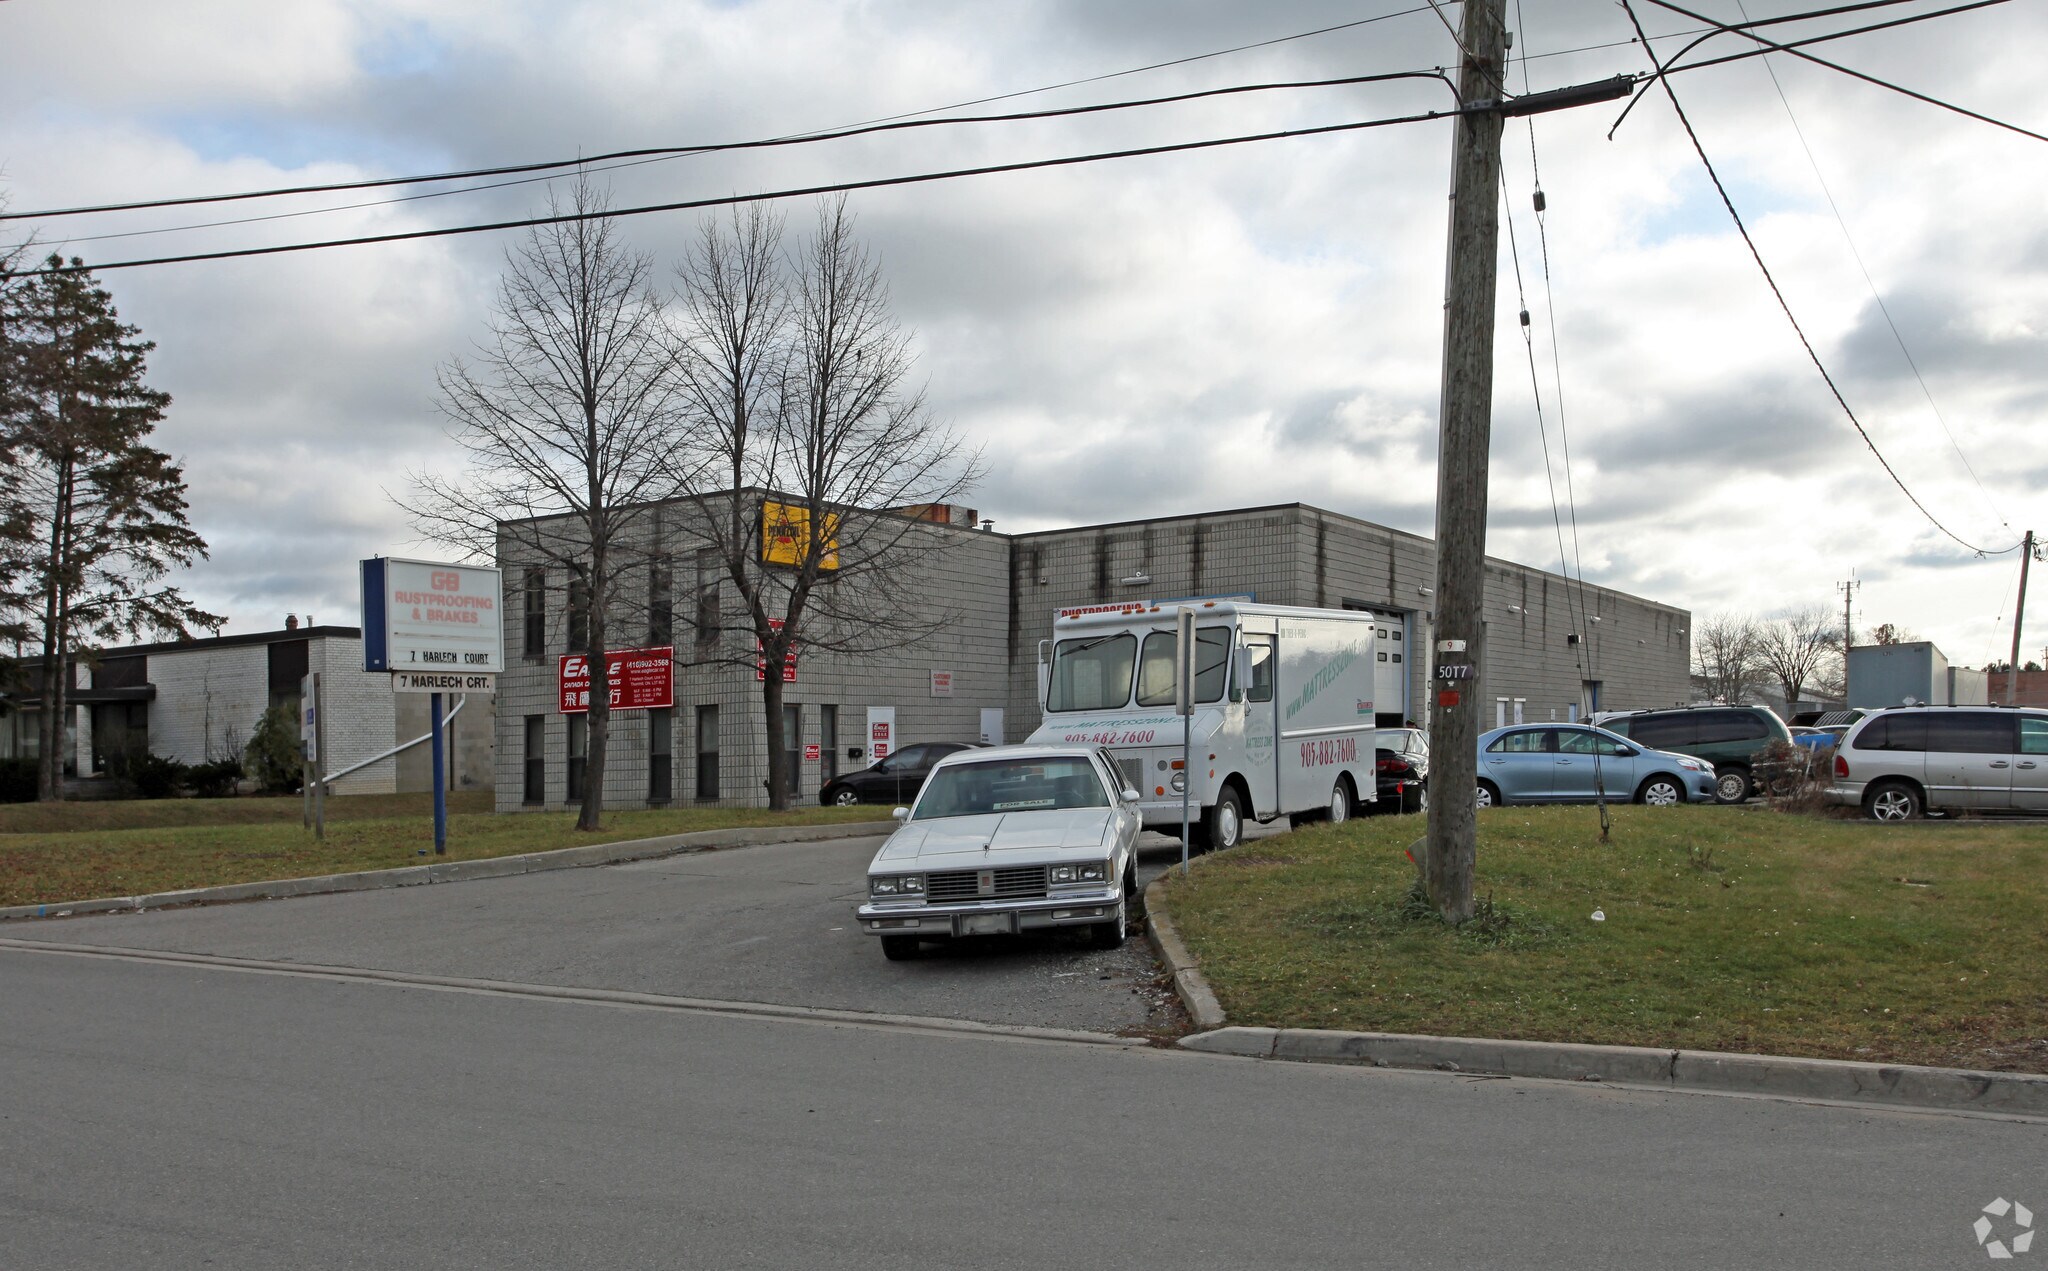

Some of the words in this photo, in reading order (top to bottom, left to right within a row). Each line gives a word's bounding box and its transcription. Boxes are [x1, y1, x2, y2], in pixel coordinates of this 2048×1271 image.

[431, 571, 460, 592] GB
[395, 591, 493, 610] RUSTPROOFING
[412, 608, 421, 620] &
[427, 608, 479, 624] BRAKES
[1447, 641, 1453, 650] 9
[410, 651, 416, 662] 7
[423, 651, 457, 662] HARLECH
[464, 653, 489, 664] COURT
[564, 658, 622, 678] EAE
[1439, 665, 1468, 679] 50T7
[401, 676, 408, 688] 7
[411, 675, 463, 688] HARLECH
[466, 677, 490, 689] CRT.
[1300, 737, 1356, 768] 905-882-7600
